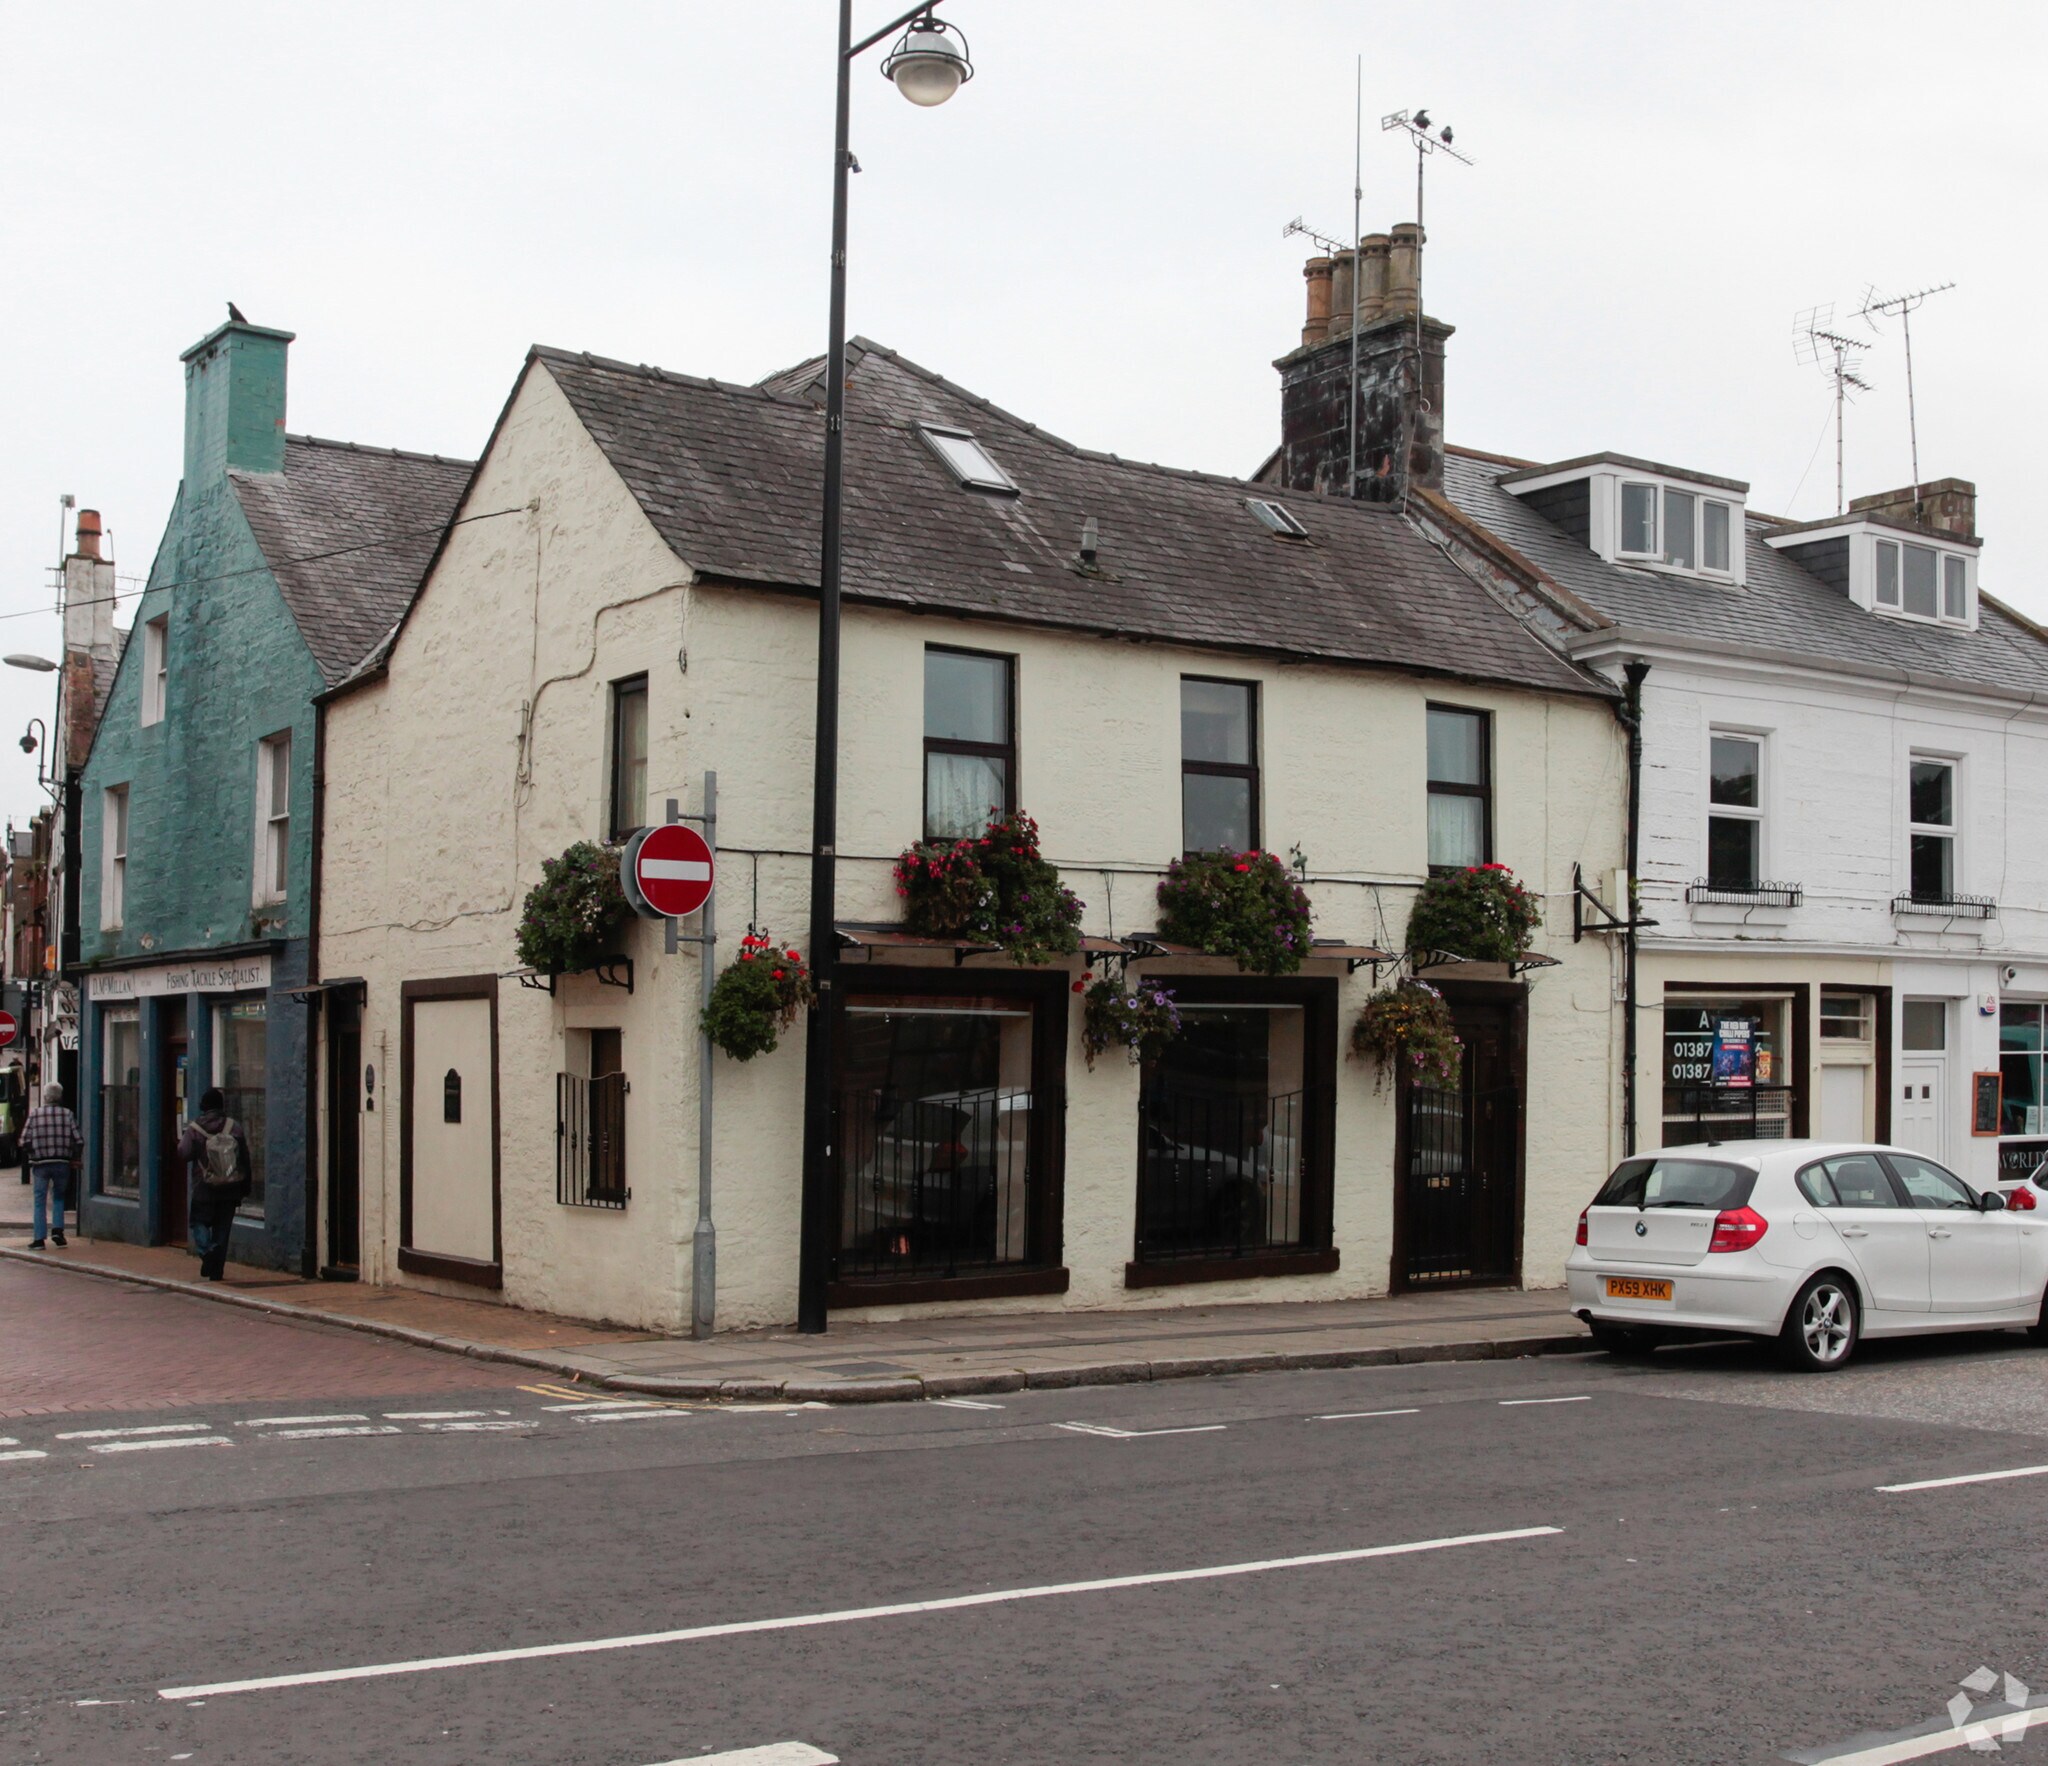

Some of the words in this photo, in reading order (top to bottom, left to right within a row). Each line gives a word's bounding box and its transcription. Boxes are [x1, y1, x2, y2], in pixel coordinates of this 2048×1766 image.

[192, 969, 216, 987] TACKLE
[1699, 1010, 1710, 1029] A
[1674, 1042, 1713, 1058] 01387
[1672, 1063, 1712, 1080] 01387
[1610, 1280, 1640, 1296] PX59
[1642, 1282, 1666, 1298] XHK
